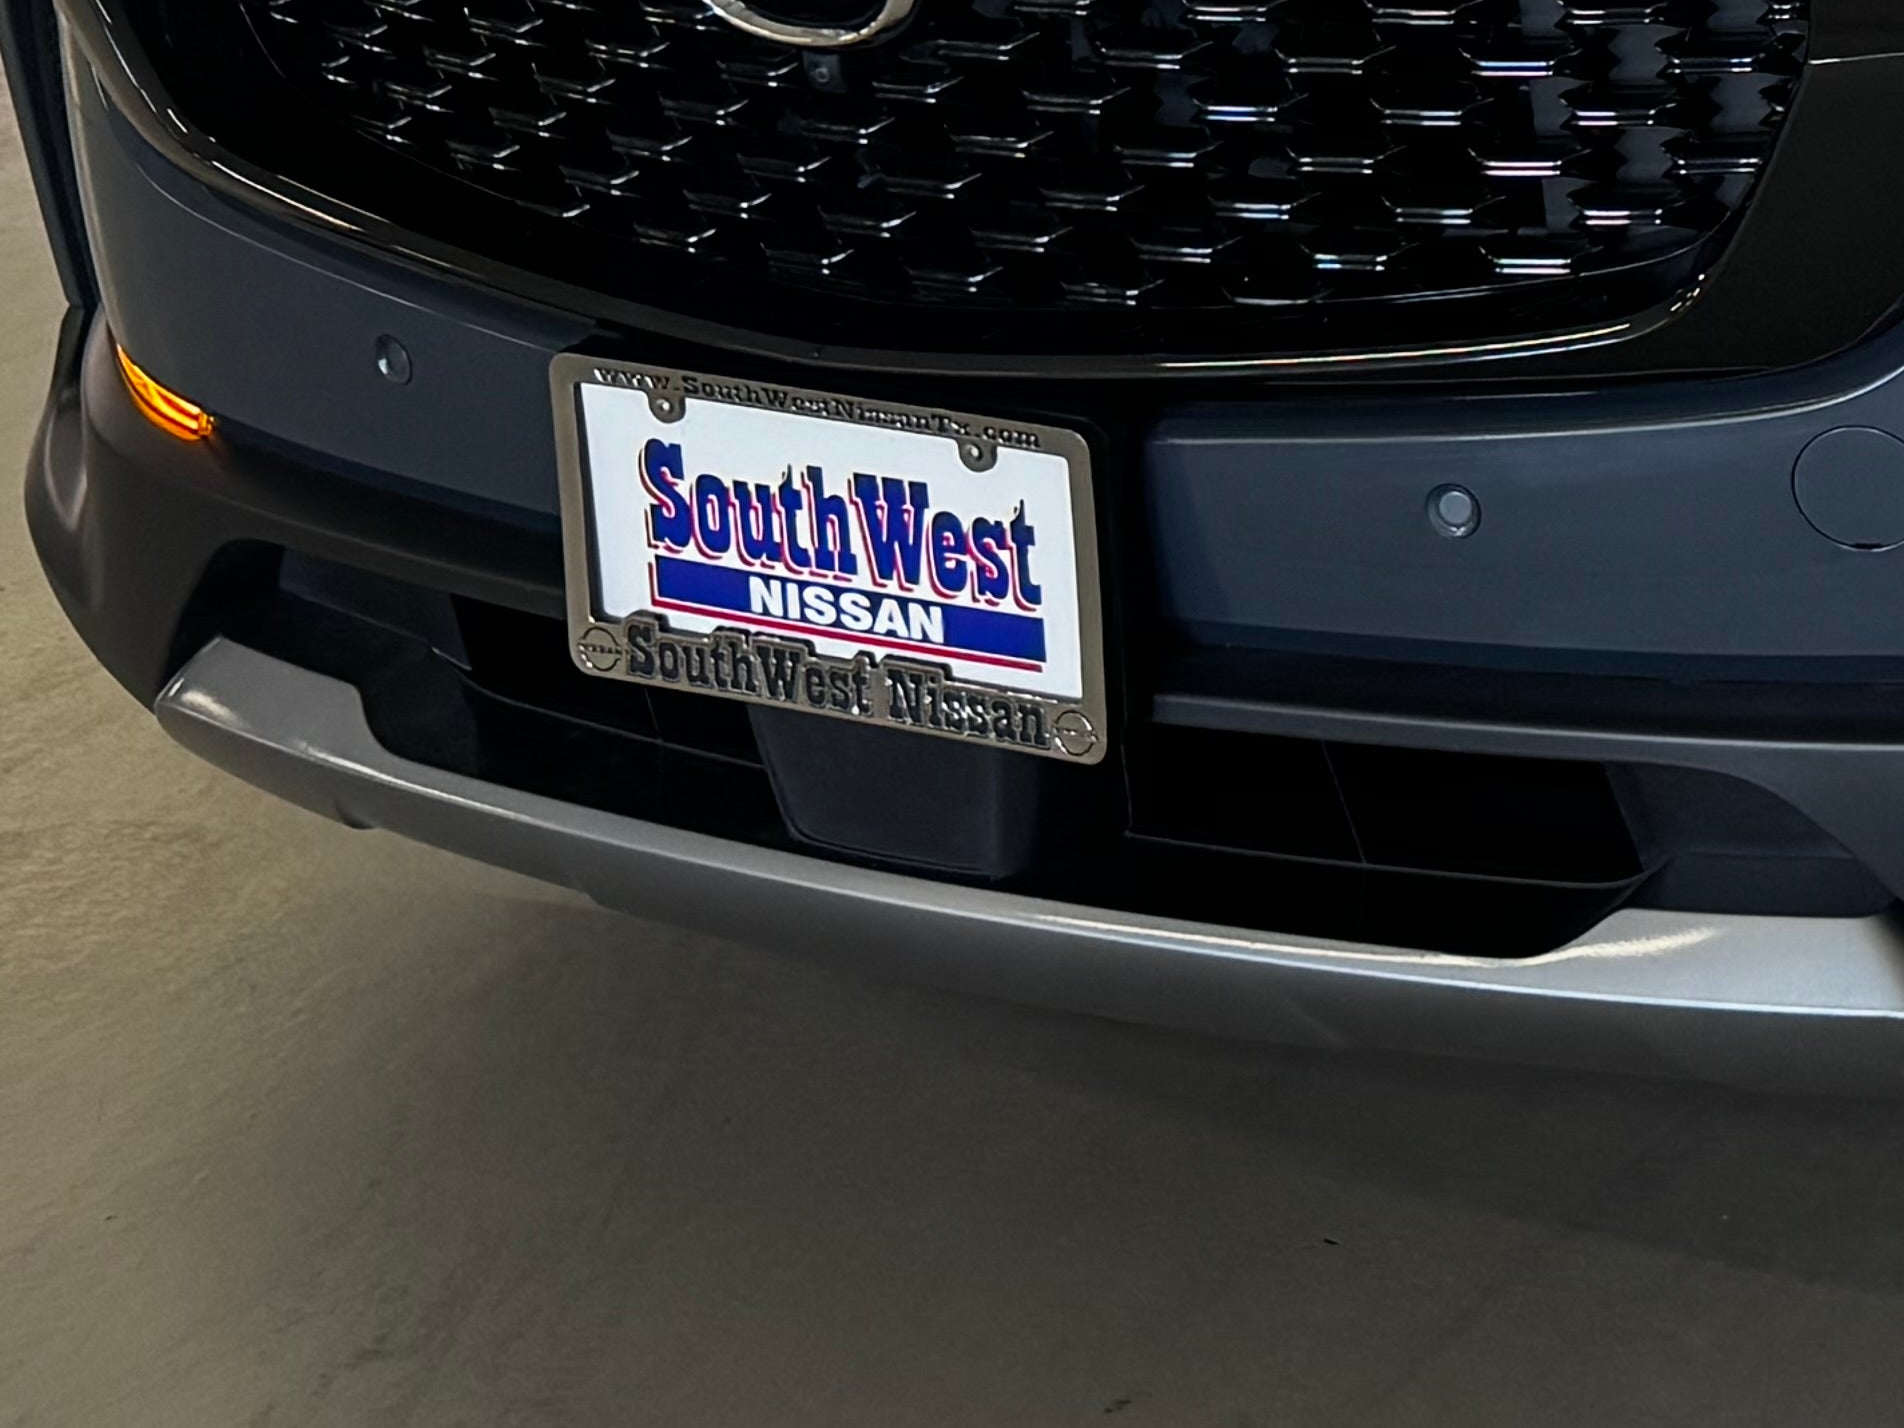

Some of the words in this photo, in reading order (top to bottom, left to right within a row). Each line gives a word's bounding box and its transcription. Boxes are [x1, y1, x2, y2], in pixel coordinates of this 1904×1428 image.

[593, 367, 1042, 451] www.SouthWestNissanTx.com
[749, 575, 944, 644] NISSAN
[625, 624, 874, 719] SouthWest
[887, 665, 1052, 750] Nissan
